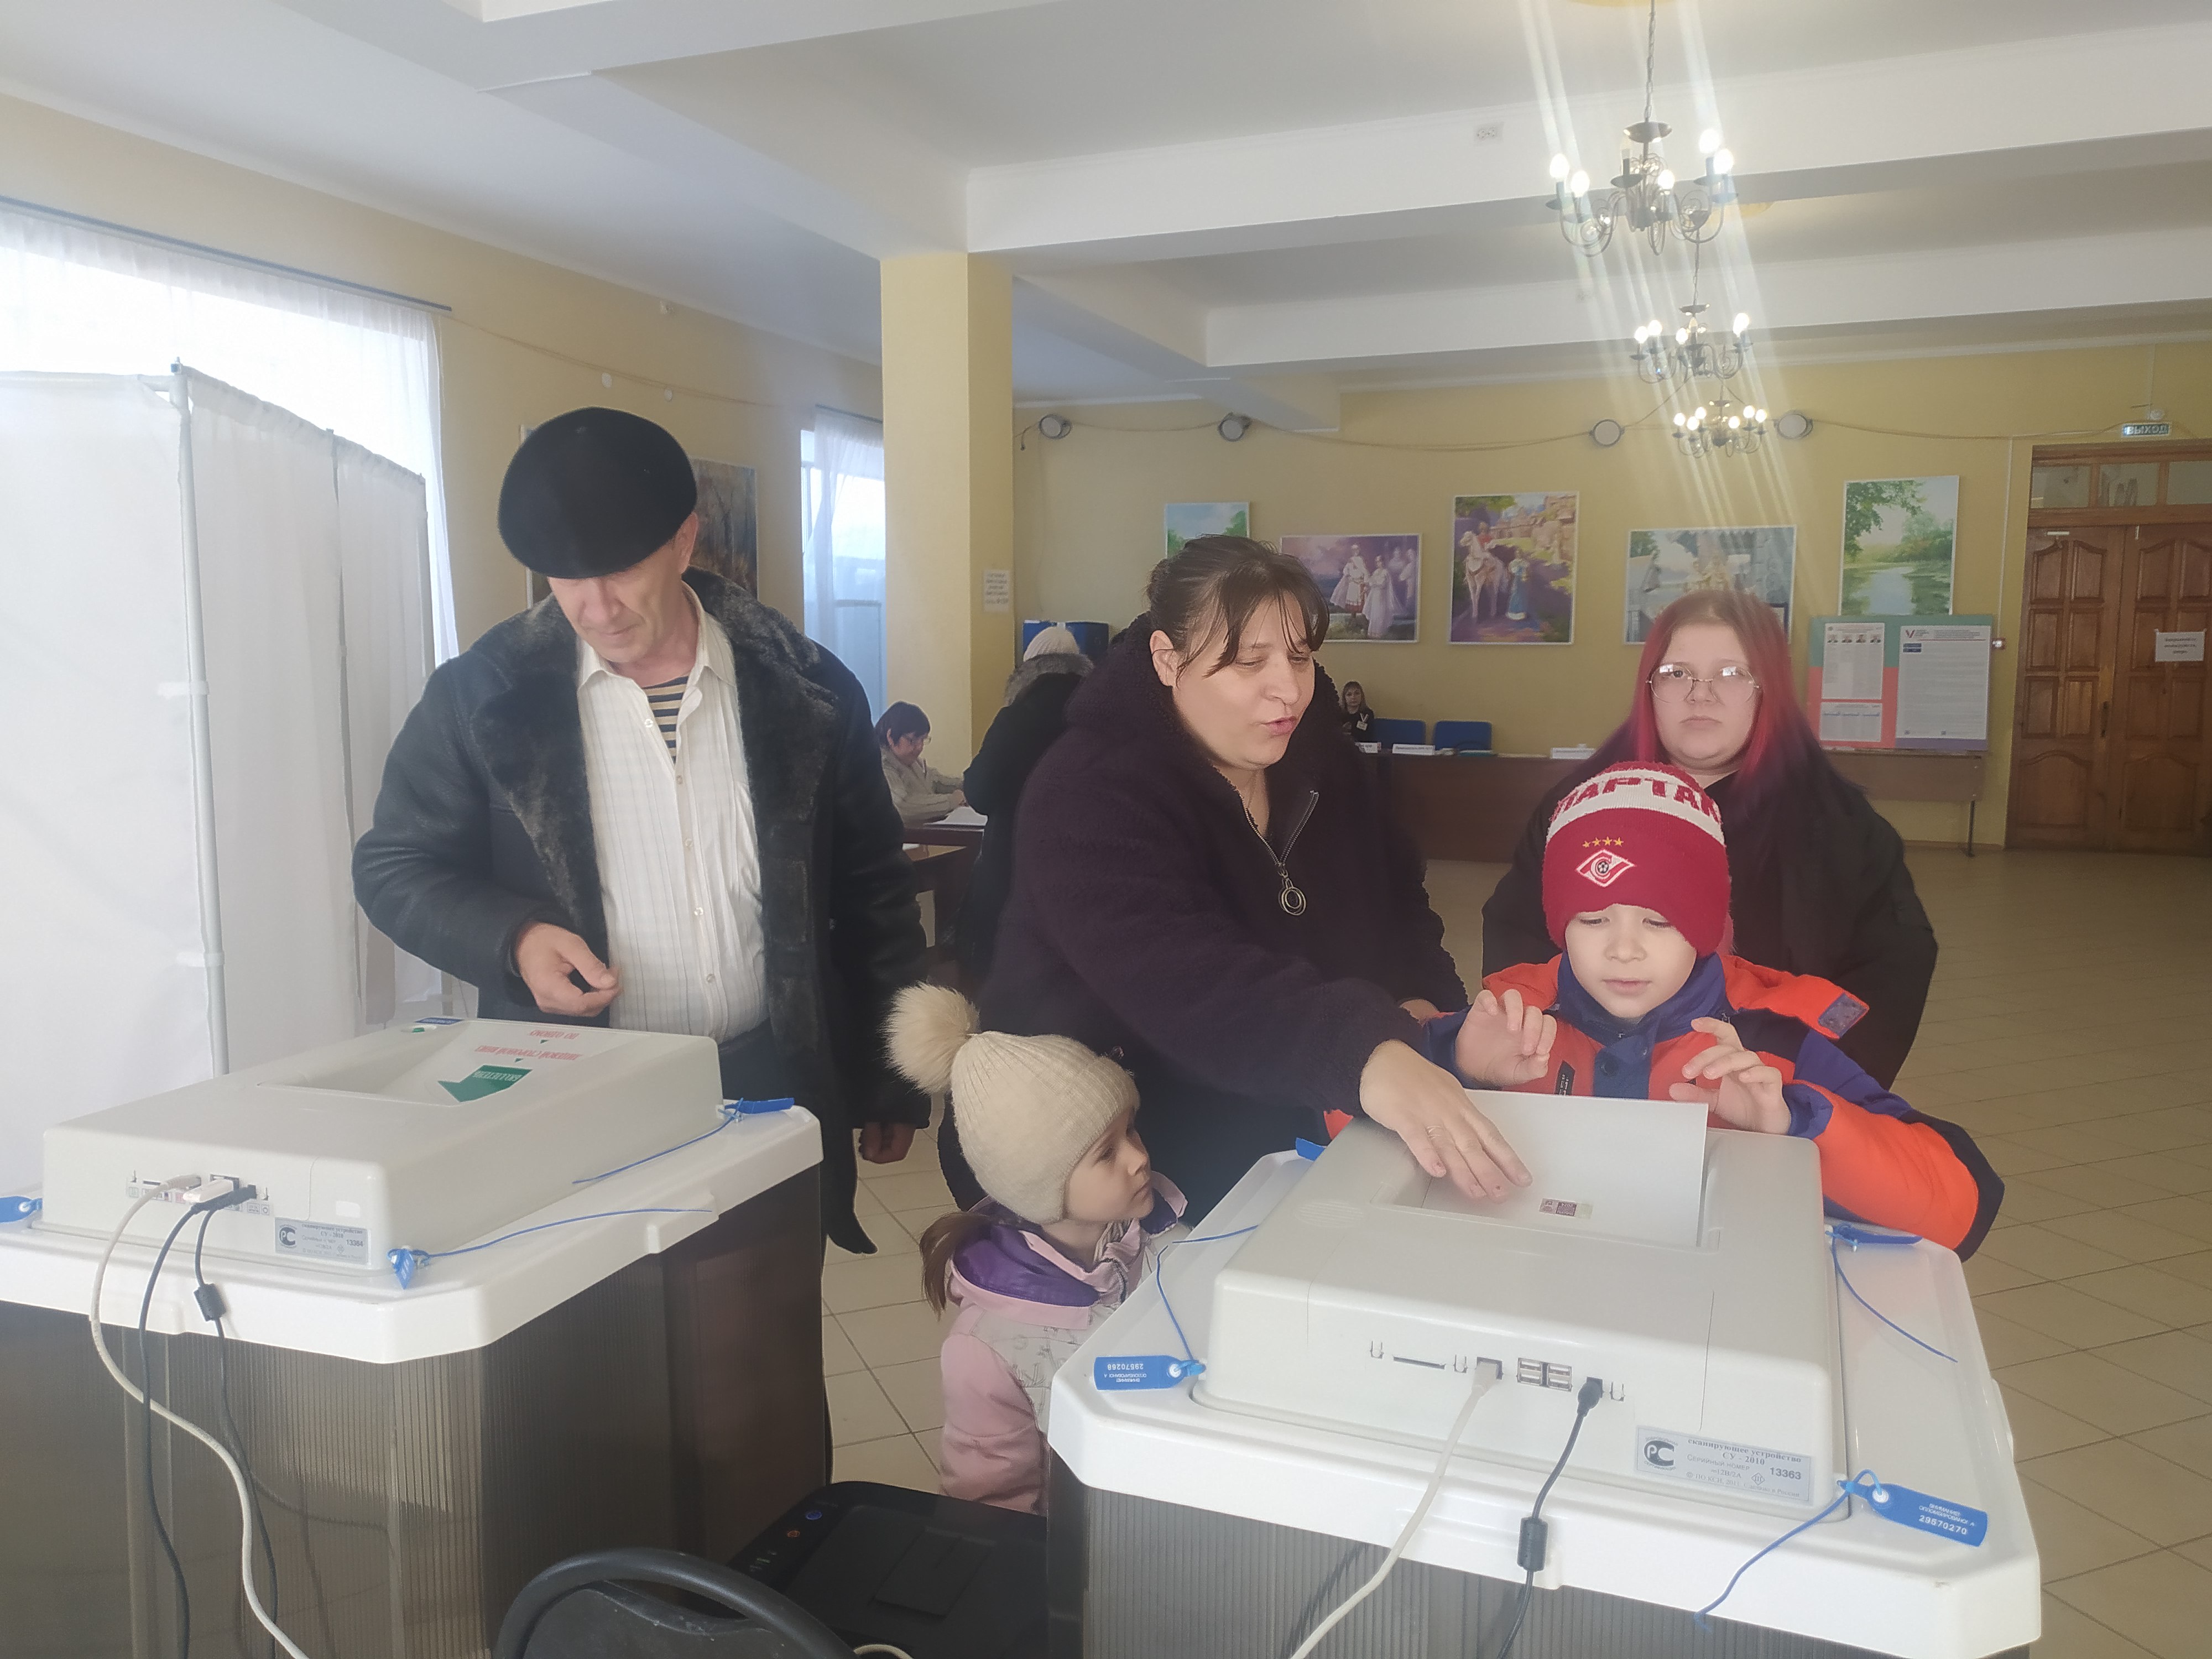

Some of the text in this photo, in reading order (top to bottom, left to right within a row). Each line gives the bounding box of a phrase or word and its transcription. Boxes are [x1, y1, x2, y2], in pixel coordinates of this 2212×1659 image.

[2127, 425, 2168, 435] ВЫХОД
[1688, 1439, 1801, 1463] сканирующее устройство
[1745, 1455, 1765, 1465] 2010
[1770, 1467, 1802, 1480] 13363
[1918, 1515, 1967, 1535] 29570270
